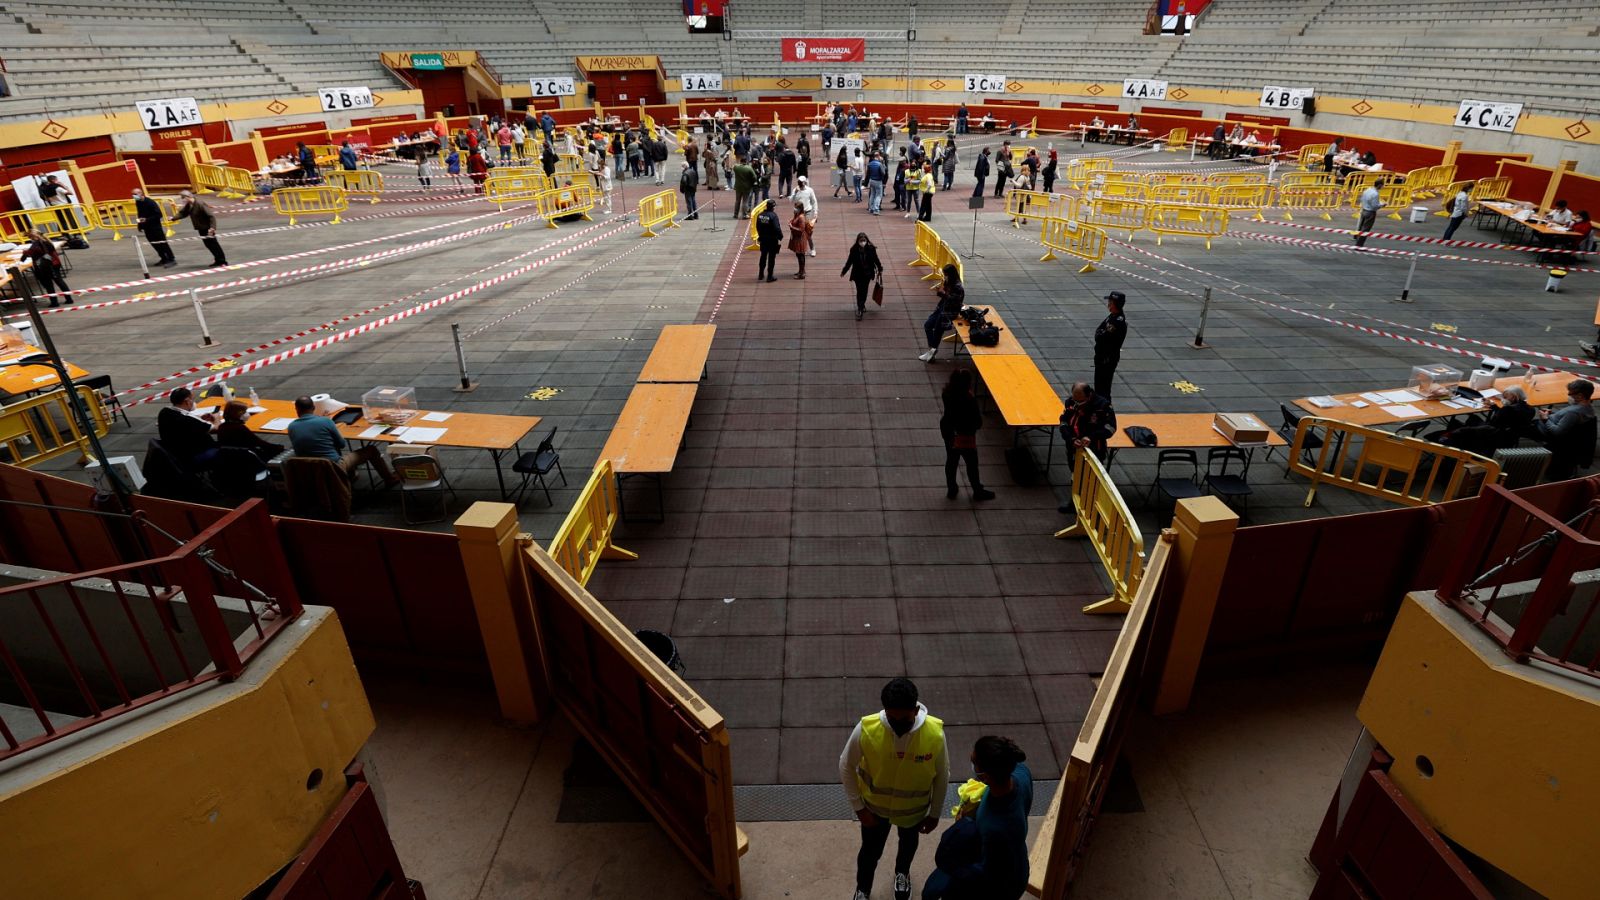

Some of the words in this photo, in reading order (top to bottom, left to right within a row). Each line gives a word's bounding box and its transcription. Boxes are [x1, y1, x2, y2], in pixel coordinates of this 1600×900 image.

[413, 58, 442, 66] SALIDA
[535, 82, 543, 95] 2
[548, 82, 557, 95] C
[686, 78, 693, 89] 3
[698, 78, 706, 89] A
[825, 76, 832, 88] 3
[837, 77, 845, 88] B
[968, 78, 975, 90] 3
[980, 78, 988, 90] C
[1126, 83, 1135, 96] 4
[1138, 84, 1147, 97] A
[325, 93, 336, 109] 2
[340, 92, 352, 108] B
[1265, 91, 1274, 106] 4
[1279, 92, 1290, 107] B
[145, 107, 160, 127] 2
[165, 106, 179, 125] A
[1461, 106, 1473, 125] 4
[1478, 108, 1493, 127] C
[159, 129, 192, 139] TORILES
